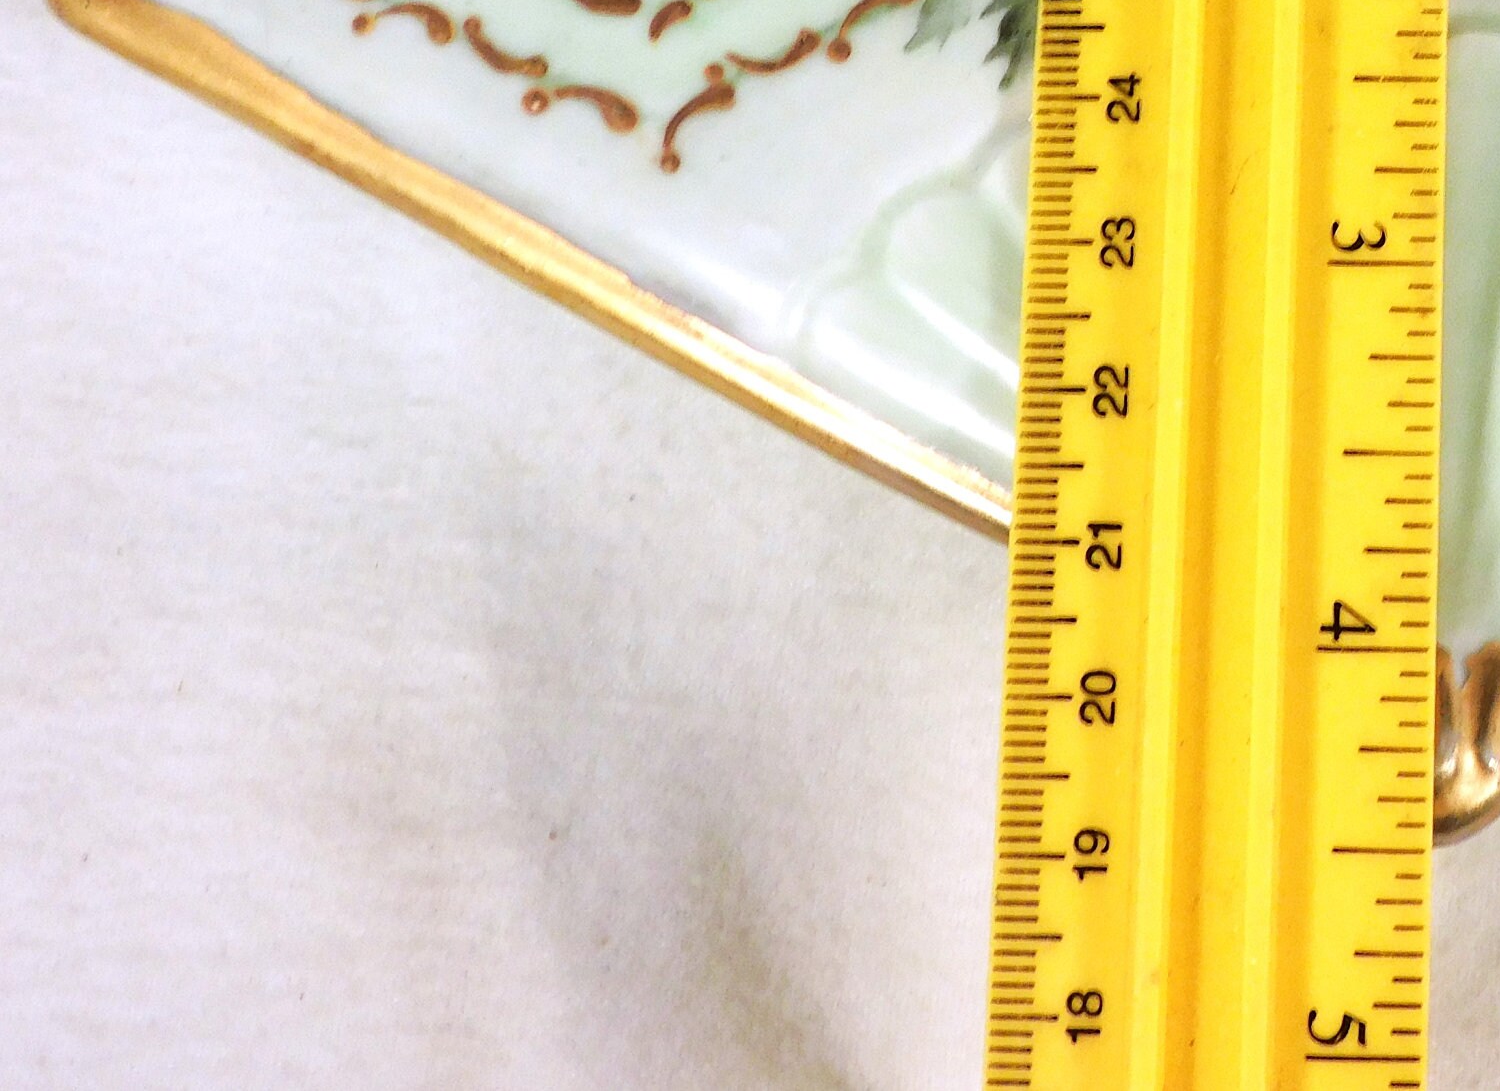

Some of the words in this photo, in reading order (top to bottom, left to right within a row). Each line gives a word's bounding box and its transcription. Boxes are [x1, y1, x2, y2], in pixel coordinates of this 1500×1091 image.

[1106, 73, 1141, 123] 24
[1099, 217, 1136, 268] 23
[1331, 221, 1388, 252] 3
[1092, 365, 1130, 418] 22
[1085, 522, 1123, 570] 21
[1319, 601, 1378, 642] 4
[1079, 670, 1117, 725] 20
[1072, 828, 1110, 881] 19
[1065, 990, 1104, 1044] 18
[1307, 1009, 1367, 1046] 5
